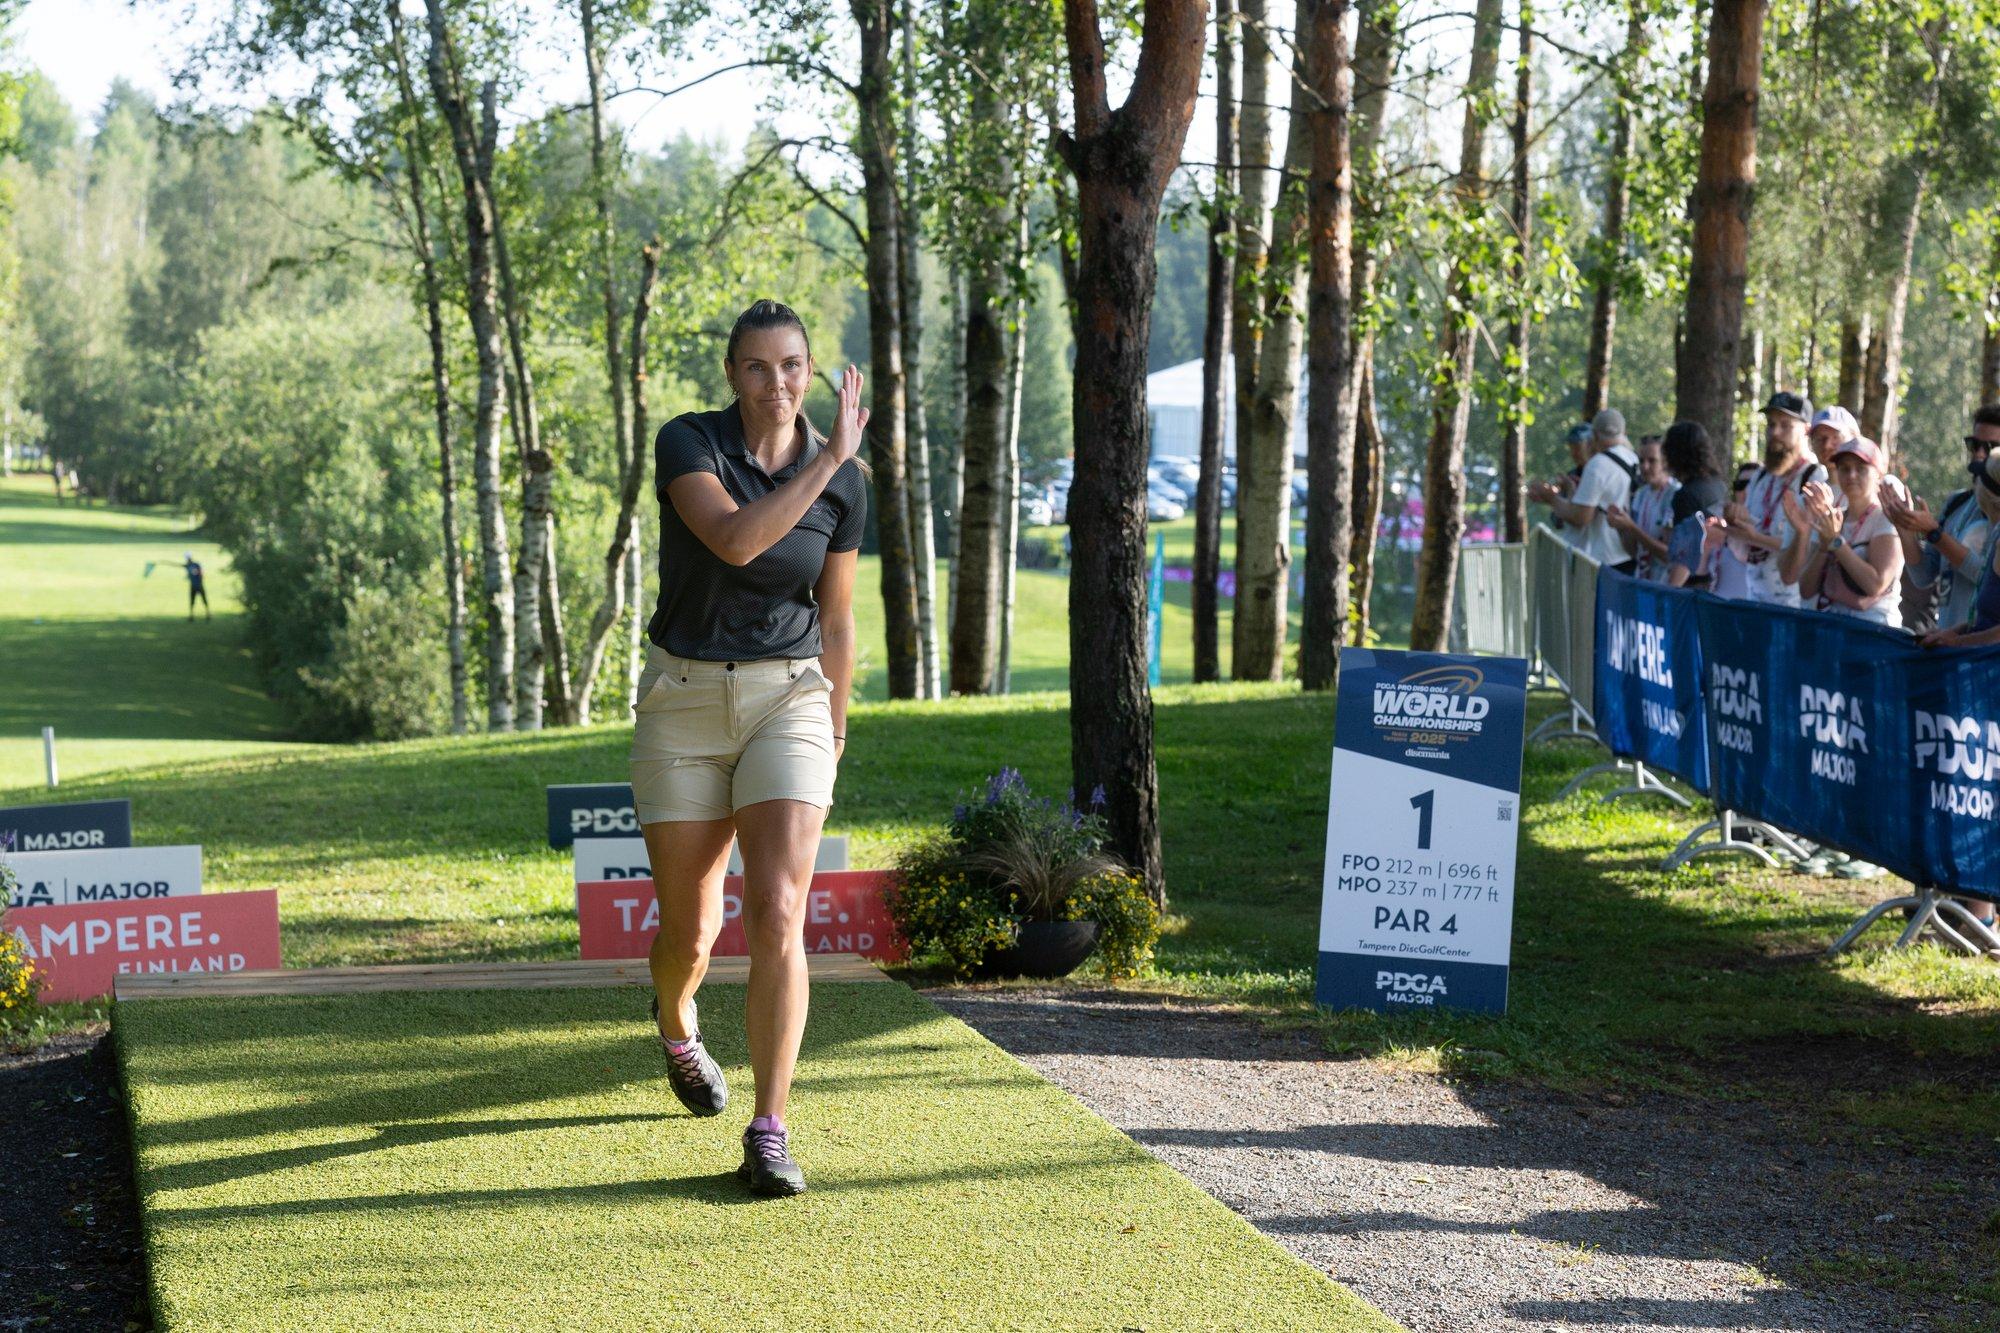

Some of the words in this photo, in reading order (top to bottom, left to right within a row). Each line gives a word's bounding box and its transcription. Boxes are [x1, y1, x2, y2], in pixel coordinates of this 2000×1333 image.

[1397, 684, 1412, 692] PRO
[1373, 689, 1490, 720] WORLD
[1373, 714, 1483, 733] CHAMPIONSHIPS
[1800, 684, 1868, 754] PDGA
[1409, 731, 1447, 745] 2025
[1717, 721, 1753, 754] MAJOR
[1405, 748, 1450, 760] discmania
[1811, 748, 1856, 786] MAJOR
[1931, 780, 1994, 820] MAJOR
[570, 806, 642, 833] PDG
[1410, 789, 1434, 849] 1
[24, 829, 105, 851] MAJOR
[1342, 854, 1380, 872] FPO
[1386, 858, 1413, 875] 212
[1418, 865, 1432, 876] m
[1448, 863, 1481, 880] 696
[1487, 864, 1498, 881] ft
[77, 881, 169, 901] MAJOR
[1338, 876, 1381, 893] MPO
[1387, 880, 1417, 896] 237
[1423, 887, 1437, 898] m
[1453, 885, 1483, 901] 777
[1488, 886, 1499, 902] ft
[1374, 906, 1431, 933] PAR
[1440, 914, 1458, 935] 4
[1359, 940, 1396, 953] Tampere
[1399, 943, 1471, 957] DiscGolfCenter
[1375, 971, 1448, 995] PDGA
[1386, 992, 1434, 1005] MAJOR
